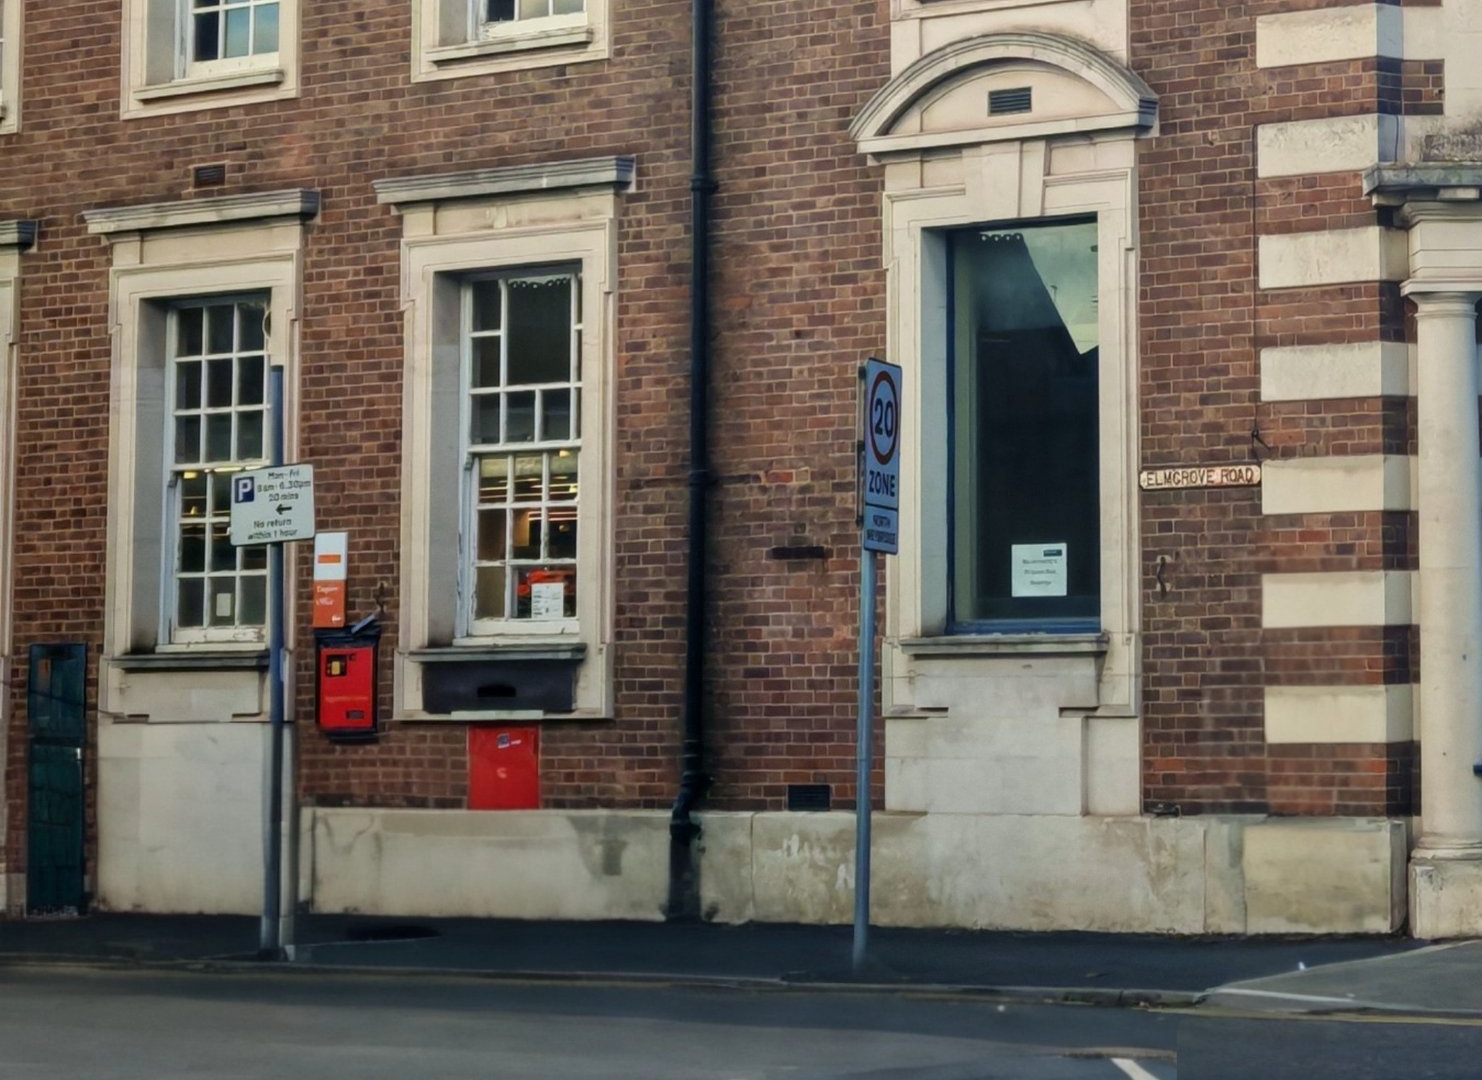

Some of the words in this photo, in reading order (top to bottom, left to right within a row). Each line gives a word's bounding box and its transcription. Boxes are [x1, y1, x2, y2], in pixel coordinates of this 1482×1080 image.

[874, 398, 894, 437] 20
[869, 471, 895, 497] ZONE
[1146, 469, 1215, 487] ELMGROVE
[1221, 467, 1254, 484] ROAD
[238, 479, 252, 501] P
[253, 520, 264, 528] No
[266, 519, 292, 527] return
